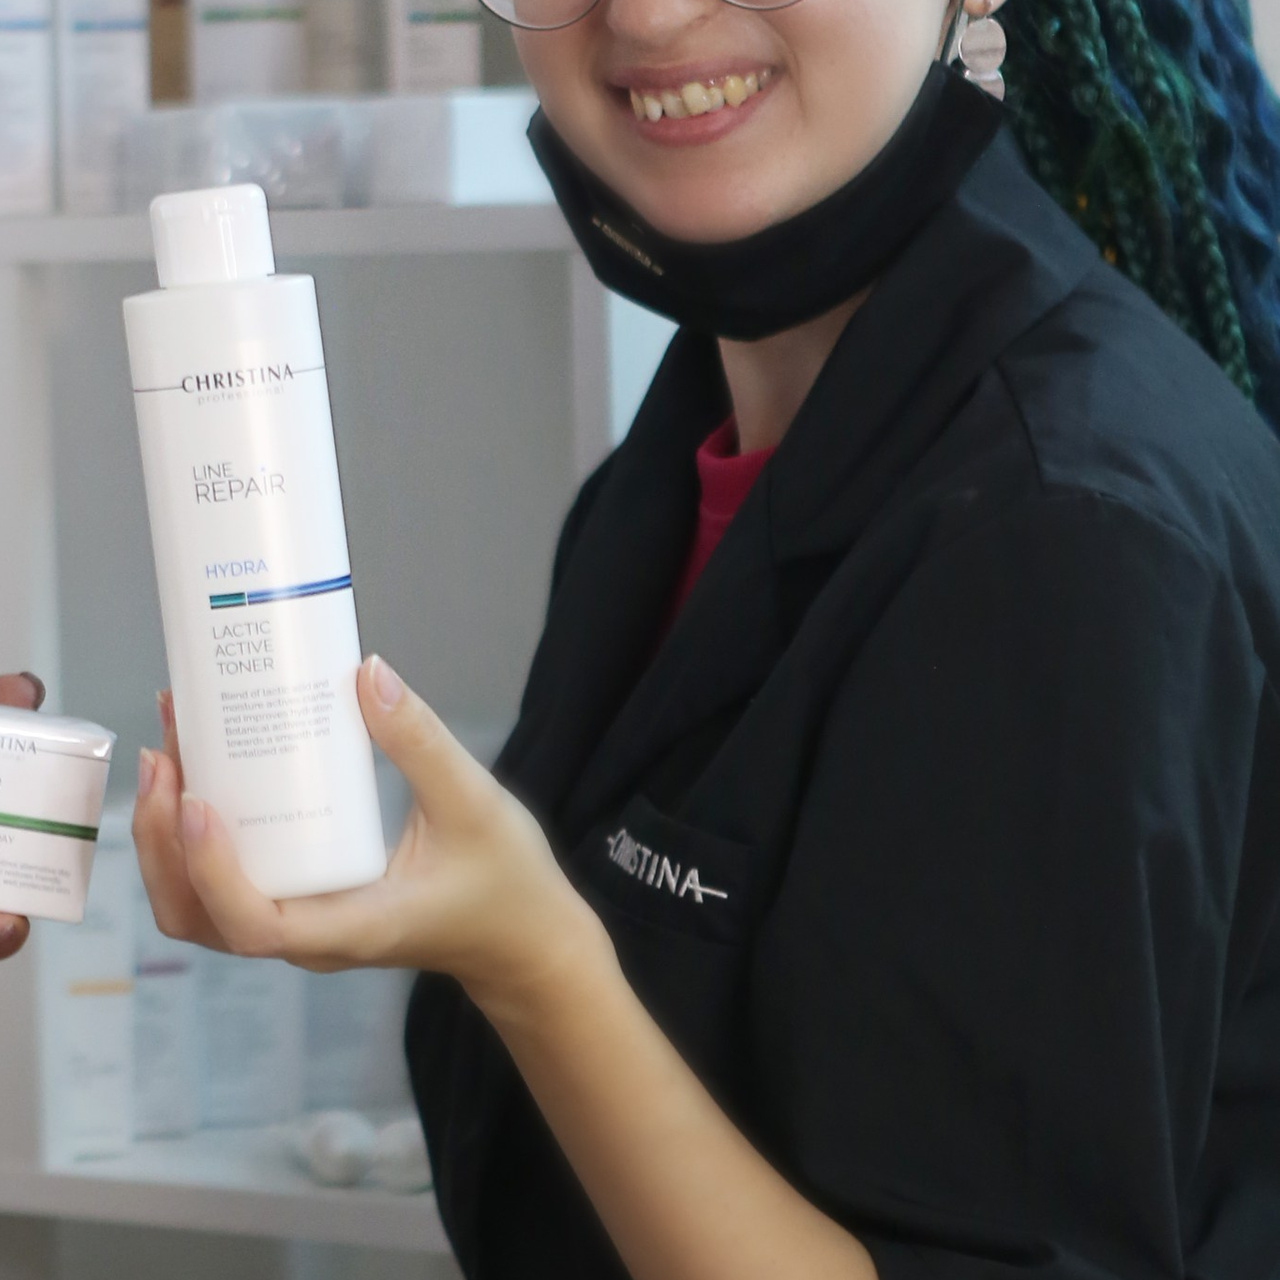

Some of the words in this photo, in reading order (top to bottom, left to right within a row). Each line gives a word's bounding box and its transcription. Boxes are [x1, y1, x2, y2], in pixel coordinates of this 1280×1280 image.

[181, 363, 294, 394] CHRISTINA
[192, 461, 234, 482] LINE
[194, 468, 287, 505] REPAIR
[205, 559, 269, 579] HYDRA
[212, 620, 272, 640] LACTIC
[215, 639, 274, 658] ACTIVE
[216, 657, 275, 676] TONER
